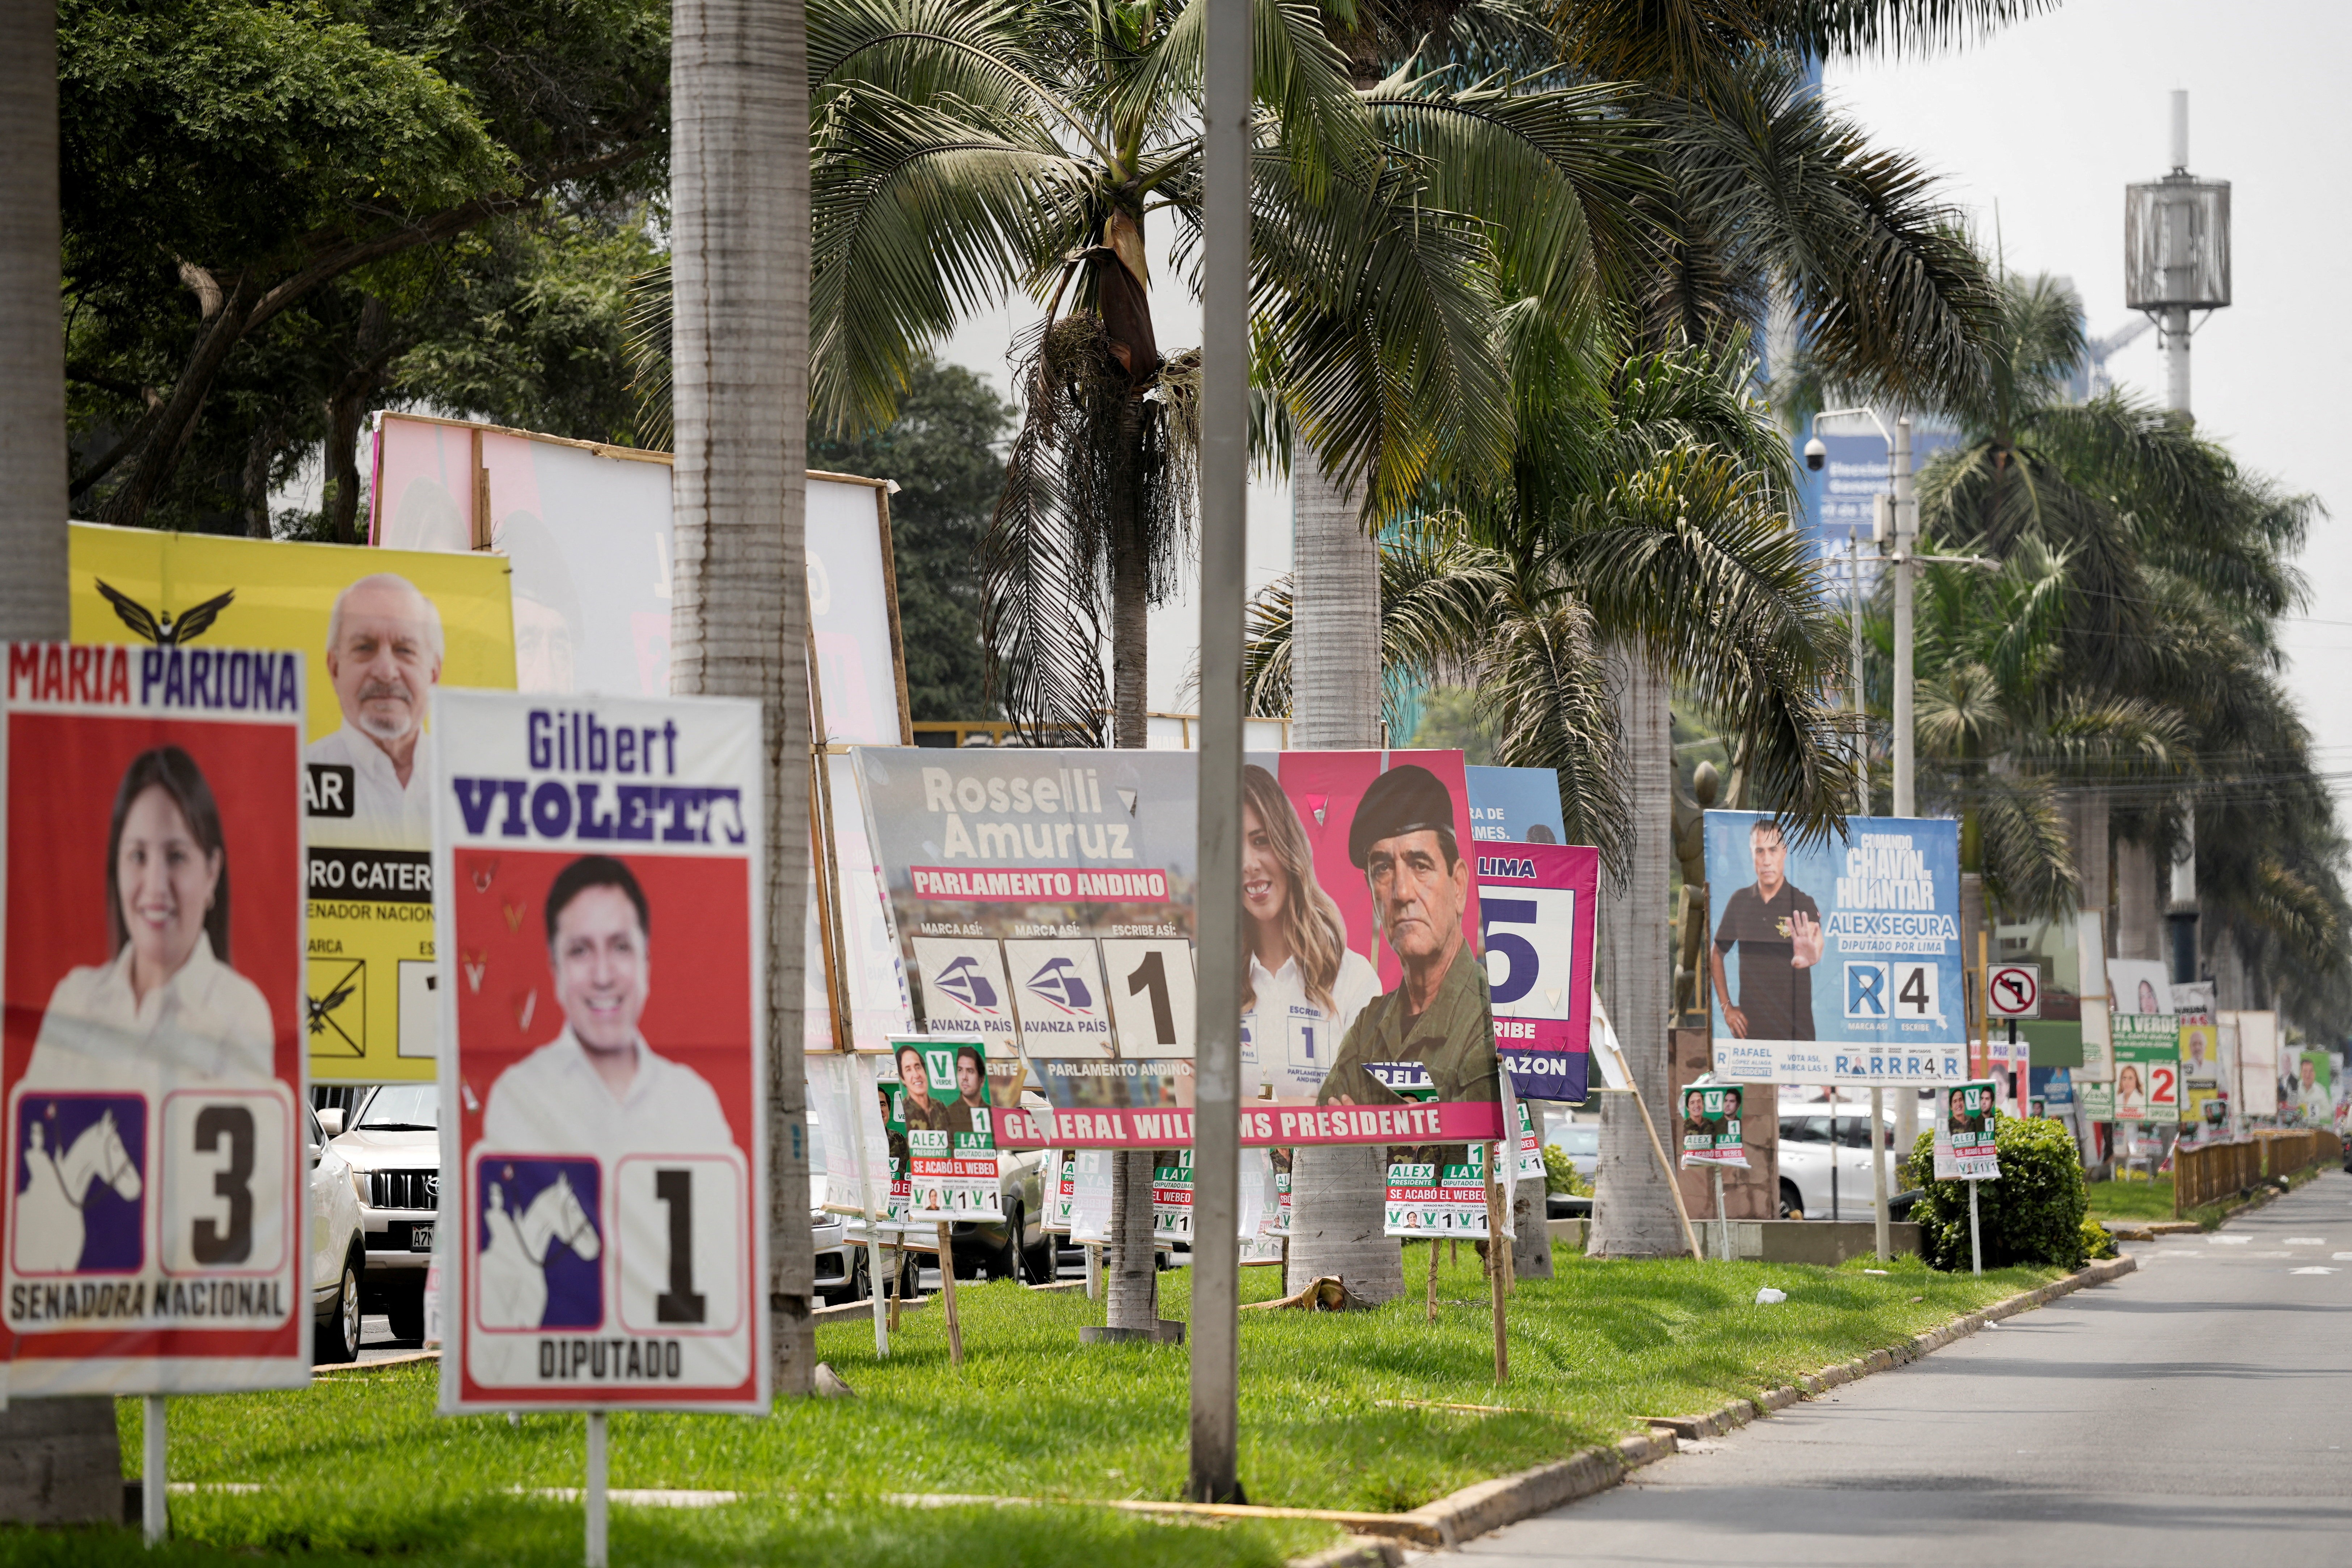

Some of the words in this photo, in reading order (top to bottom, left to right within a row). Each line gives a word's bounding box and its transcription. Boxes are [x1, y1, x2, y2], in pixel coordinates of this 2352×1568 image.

[7, 642, 131, 705] MARIA
[141, 647, 297, 713] PARIONA
[528, 708, 678, 776] Gilbert
[921, 767, 1102, 813] Rosselli
[1487, 808, 1505, 820] DE
[944, 813, 1134, 859] Amuruz
[1861, 833, 1913, 850] COMANDO
[1478, 857, 1537, 879] LIMA
[916, 870, 1072, 896] PARLAMENTO
[1077, 873, 1165, 897] ANDINO
[921, 923, 961, 935] MARCA
[962, 921, 983, 936] ASÍ:
[1015, 924, 1057, 937] MARCA
[1058, 921, 1080, 937] ASÍ:
[1112, 924, 1156, 937] ESCRIBE
[1157, 921, 1176, 936] ASÍ:
[1828, 912, 1877, 935] ALEX
[1881, 916, 1955, 936] SEGURA
[1480, 898, 1539, 1004] 5
[1842, 940, 1892, 951] DIPUTADO
[1895, 941, 1914, 951] POR
[1917, 941, 1942, 952] LIMA
[1128, 951, 1176, 1045] 1
[1849, 966, 1885, 1014] R
[1899, 967, 1929, 1014] 4
[931, 1020, 980, 1031] AVANZA
[985, 1018, 1012, 1032] PAÍS
[1024, 1021, 1075, 1033] AVANZA
[1078, 1018, 1107, 1033] PAÍS
[1848, 1022, 1875, 1031] MARCA
[1901, 1023, 1930, 1032] ESCRIBE
[1302, 1027, 1314, 1058] 1
[1733, 1048, 1772, 1057] RAFAEL
[931, 1054, 947, 1078] V
[1048, 1063, 1137, 1076] PARLAMENTO
[1141, 1063, 1190, 1076] ANDINO
[1925, 1058, 1935, 1073] 4
[2152, 1068, 2174, 1102] 2
[1710, 1094, 1719, 1106] V
[1968, 1091, 1976, 1103] V
[976, 1111, 986, 1130] 1
[1280, 1109, 1441, 1138] PRESIDENTE
[1731, 1122, 1736, 1133] 1
[912, 1133, 945, 1146] ALEX
[961, 1133, 987, 1148] LAY
[1954, 1133, 1975, 1143] ALEX
[1979, 1132, 1991, 1140] LAY
[914, 1160, 925, 1174] SE
[926, 1159, 952, 1174] ACABÓ
[955, 1162, 965, 1174] EL
[966, 1162, 995, 1175] WEBEO
[1391, 1166, 1431, 1177] ALEX
[1450, 1166, 1483, 1178] LAY
[1532, 1158, 1540, 1169] 1
[1162, 1168, 1189, 1181] LAY
[192, 1104, 255, 1266] 3
[1390, 1189, 1403, 1199] SE
[1405, 1187, 1437, 1200] ACABÓ
[1440, 1190, 1451, 1200] EL
[959, 1192, 966, 1209] 1
[989, 1192, 998, 1209] 1
[1163, 1191, 1191, 1203] WEBEO
[1164, 1214, 1176, 1227] V
[1180, 1216, 1188, 1231] 1
[1388, 1211, 1401, 1223] V
[1424, 1212, 1436, 1225] V
[1442, 1213, 1451, 1228] 1
[1459, 1213, 1471, 1225] V
[655, 1170, 706, 1324] 1
[12, 1282, 143, 1321] SENADORA
[154, 1281, 284, 1317] NACIONAL
[538, 1339, 683, 1380] DIPUTADO
